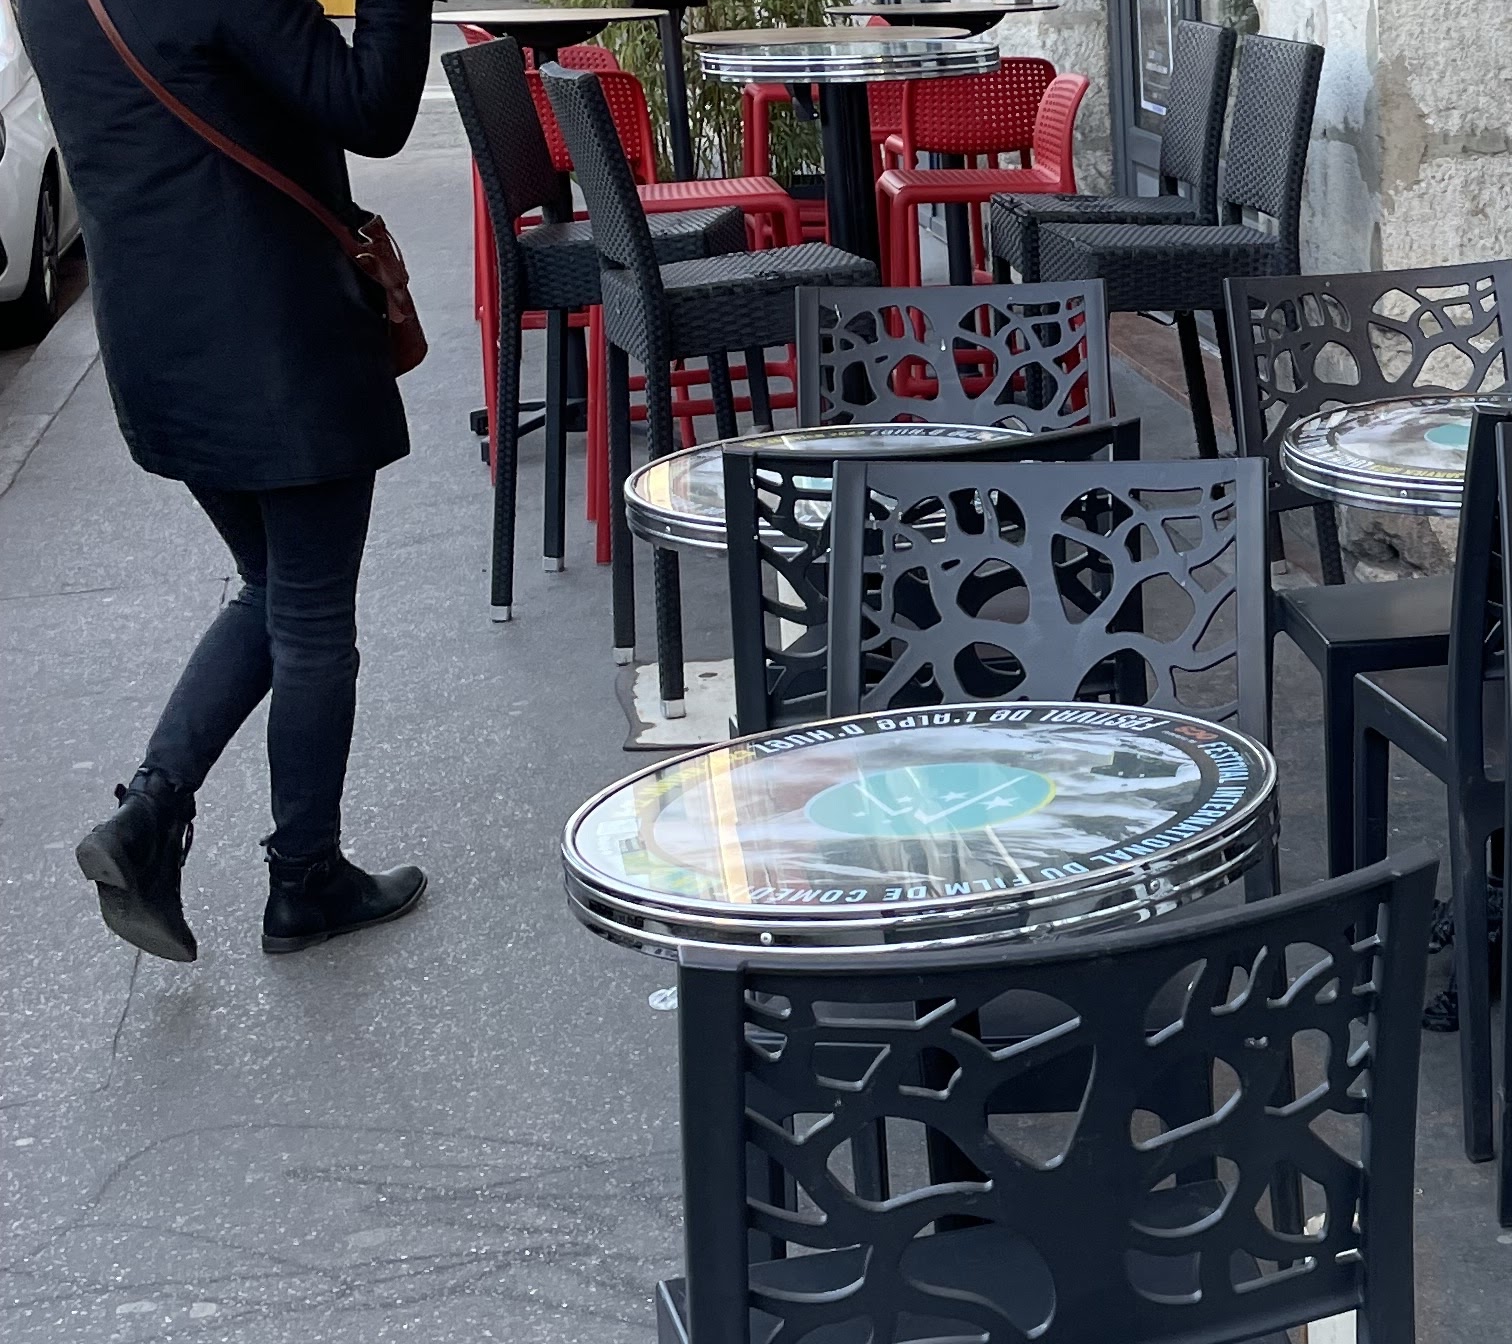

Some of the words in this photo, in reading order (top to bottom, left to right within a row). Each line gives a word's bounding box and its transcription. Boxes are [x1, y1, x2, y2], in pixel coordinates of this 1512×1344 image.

[1197, 741, 1249, 784] FESTIVAL
[1089, 786, 1247, 865] INTERNATIONAL
[1039, 861, 1090, 880] DU
[882, 885, 928, 902] DE
[943, 874, 1032, 896] FILM
